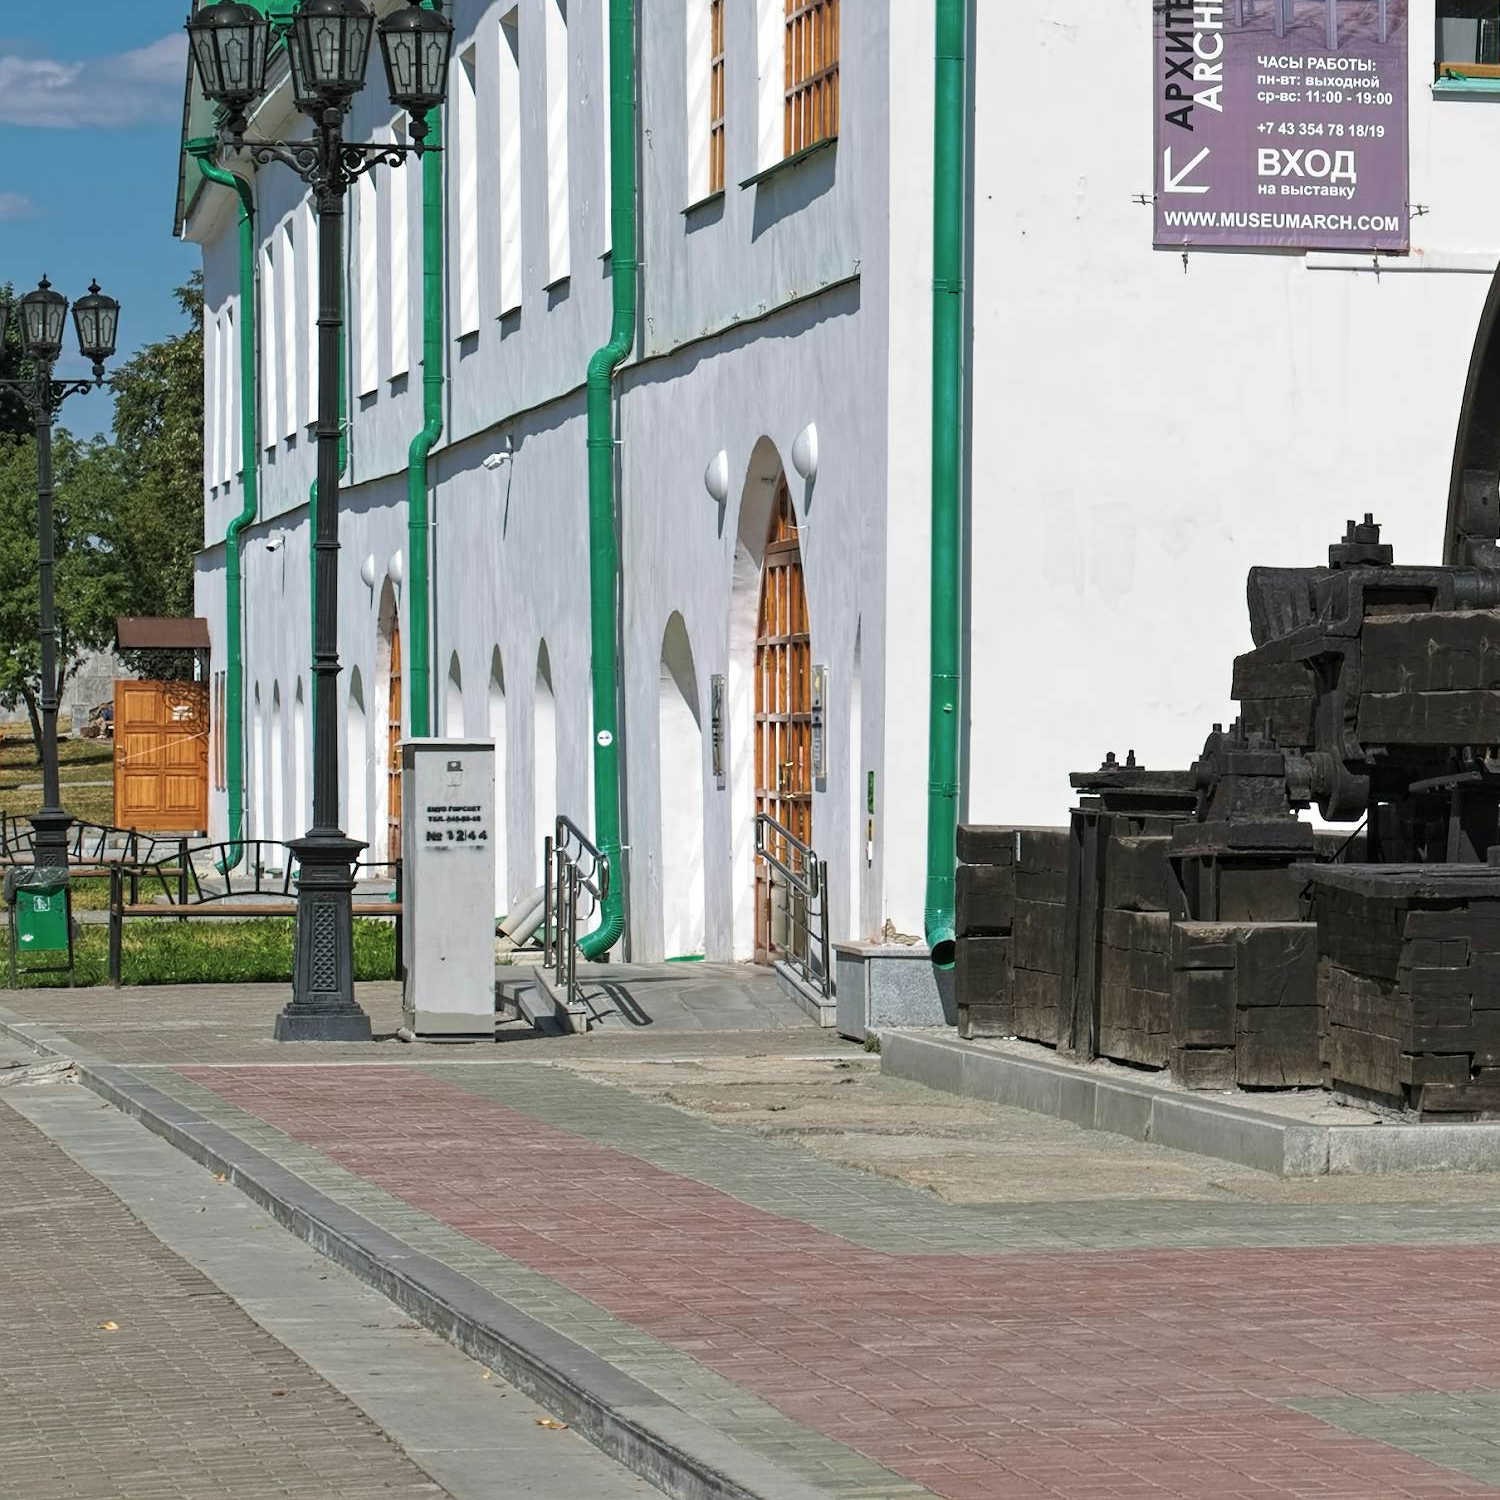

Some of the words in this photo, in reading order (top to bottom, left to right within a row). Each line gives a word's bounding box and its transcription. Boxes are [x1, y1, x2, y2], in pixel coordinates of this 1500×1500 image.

[1257, 55, 1303, 69] ЧАСЫ
[1307, 57, 1377, 72] РАБОТЫ:
[1257, 75, 1301, 86] пн-вт:
[1305, 76, 1380, 89] выходной
[1257, 91, 1301, 104] ср-вс:
[1306, 90, 1343, 104] 11:00
[1355, 92, 1393, 105] 19:00
[1257, 122, 1274, 135] +7
[1278, 122, 1295, 136] 43
[1299, 123, 1323, 136] 354
[1327, 124, 1344, 137] 78
[1348, 124, 1385, 138] 18/19
[1257, 148, 1357, 184] ВХОД
[1257, 184, 1276, 195] на
[1280, 184, 1356, 200] выставку
[1164, 211, 1400, 232] WWW.MUSEUMARCH.COM
